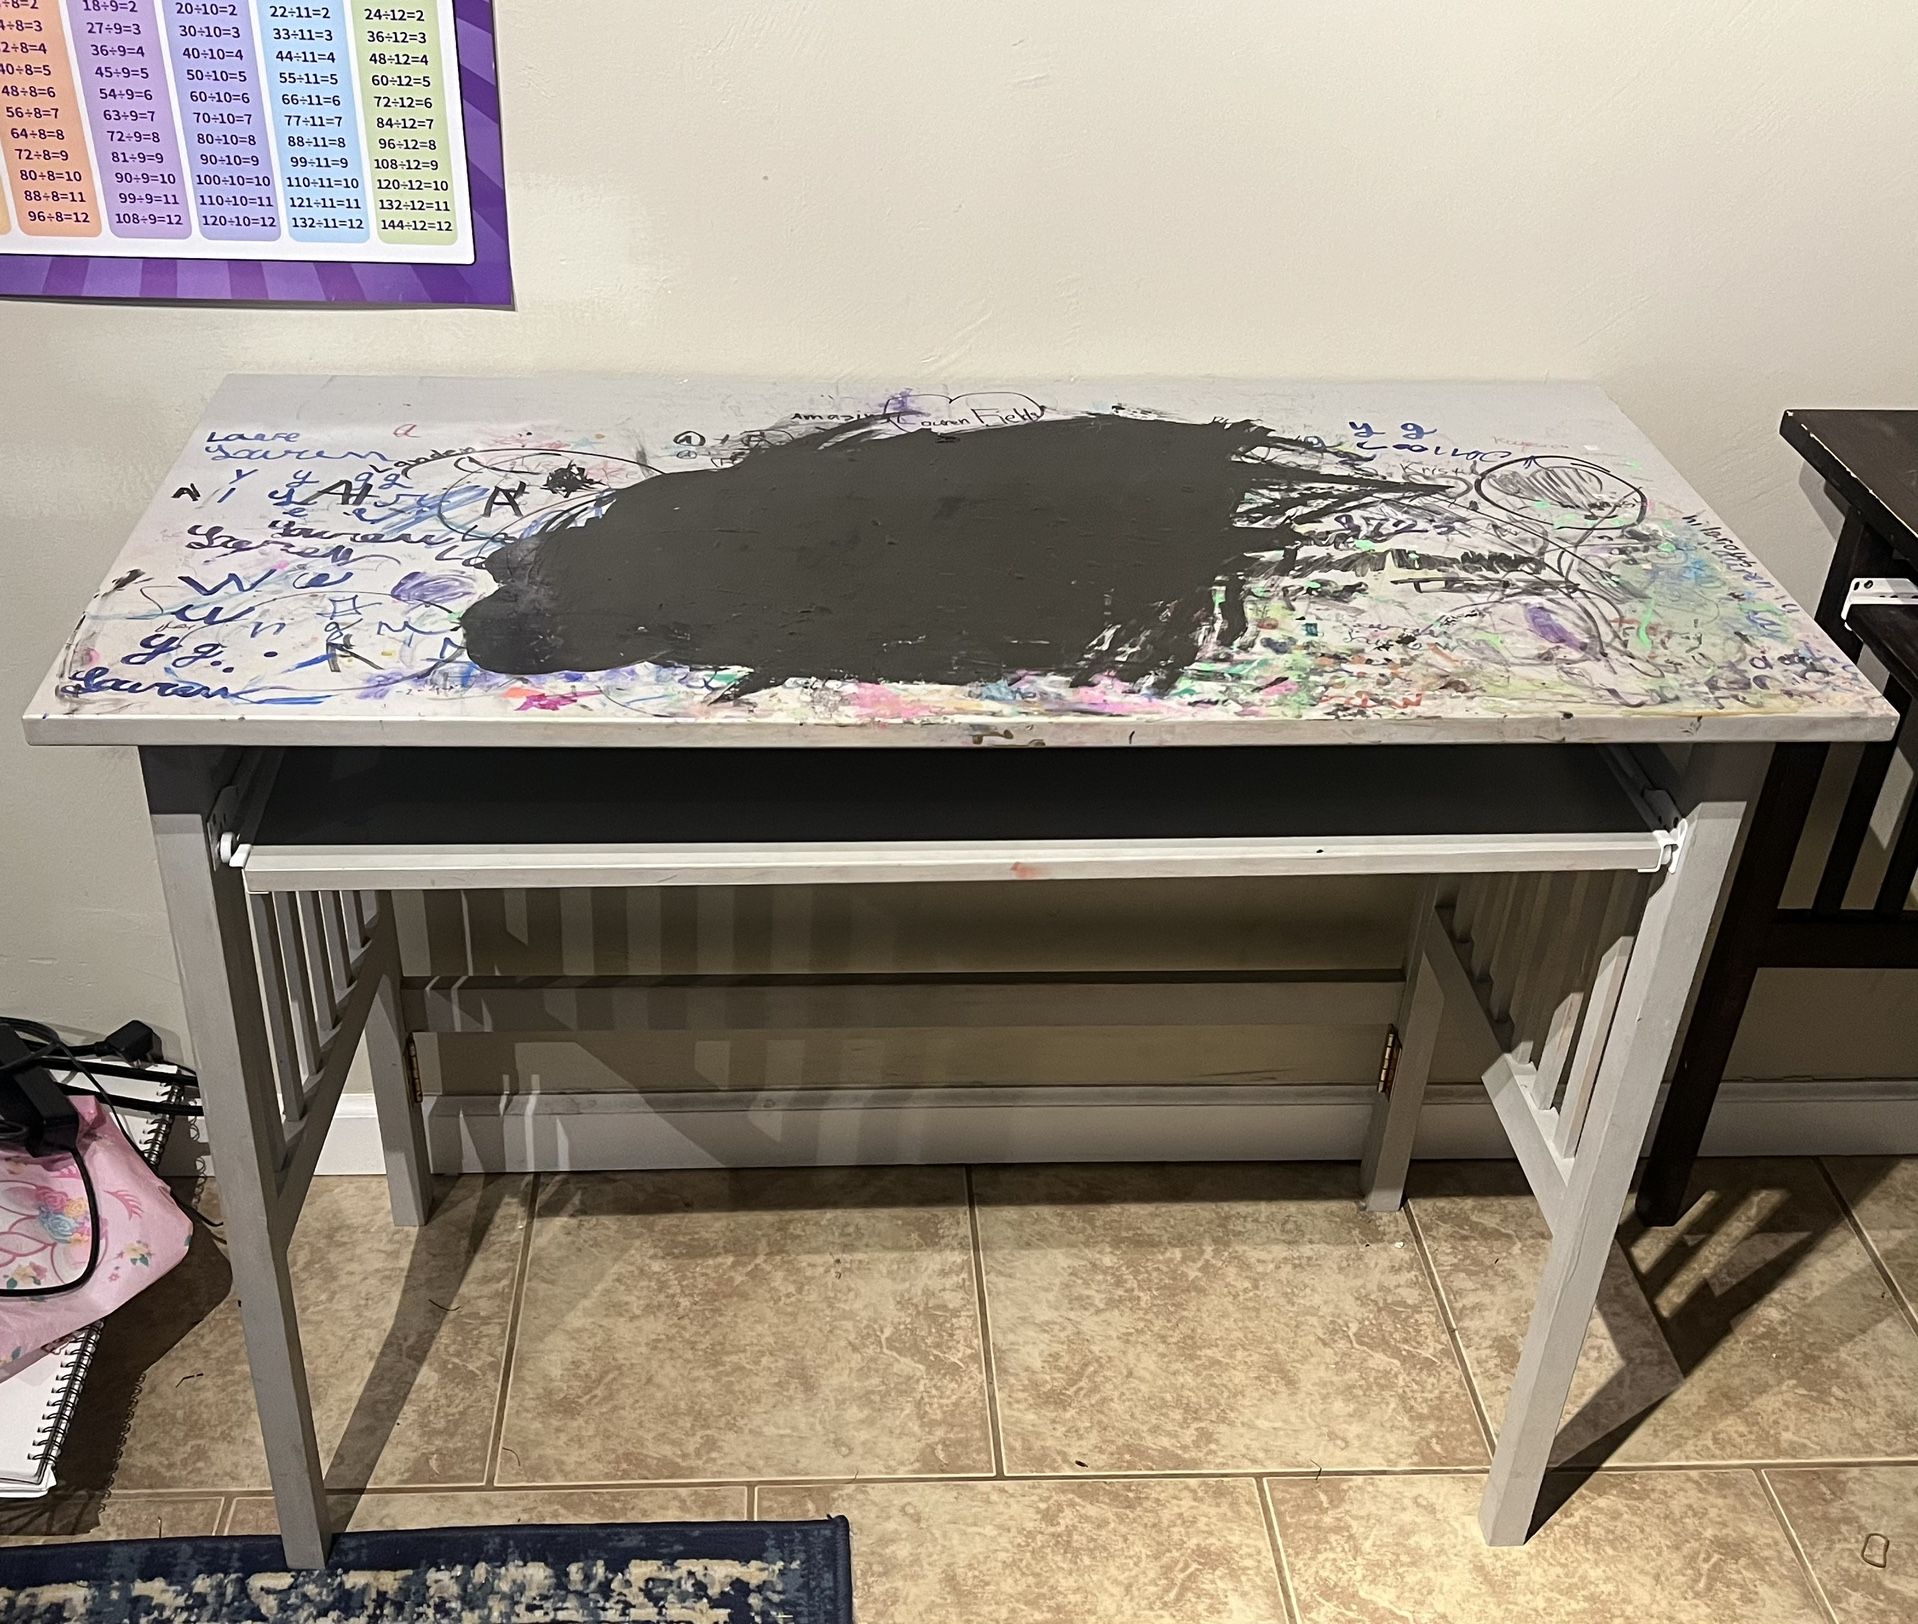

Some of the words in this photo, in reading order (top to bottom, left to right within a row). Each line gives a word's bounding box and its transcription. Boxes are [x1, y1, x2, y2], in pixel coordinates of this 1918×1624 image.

[82, 0, 139, 13] 18÷9=2
[174, 1, 239, 17] 20÷10=2
[268, 5, 332, 20] 22÷11=2
[363, 7, 426, 22] 24÷12=2
[85, 21, 142, 36] 27÷9=3
[178, 24, 241, 39] 30÷10=3
[272, 27, 334, 42] 33÷11=3
[366, 30, 427, 45] 36÷12=3
[0, 40, 48, 55] 2÷8=4
[90, 43, 146, 58] 36÷9=4
[182, 47, 244, 61] 40÷10=4
[275, 50, 337, 64] 44÷11=4
[368, 52, 430, 66] 48÷12=4
[94, 66, 150, 80] 45÷9=5
[186, 68, 248, 83] 50÷10=5
[278, 71, 339, 86] 55÷11=5
[371, 74, 431, 88] 60÷12=5
[0, 84, 57, 99] 48÷8=6
[99, 87, 153, 101] 54÷9=6
[189, 90, 251, 104] 60÷10=6
[281, 93, 341, 107] 66÷11=6
[372, 95, 433, 109] 72÷12=6
[5, 105, 60, 120] 56÷8=7
[102, 109, 156, 122] 63÷9=7
[192, 111, 253, 126] 70÷10=7
[283, 114, 343, 128] 77÷11=7
[376, 116, 435, 130] 84÷12=7
[10, 127, 66, 141] 64÷8=8
[105, 130, 161, 144] 72÷9=8
[196, 132, 257, 146] 80÷10=8
[287, 135, 347, 149] 88÷11=8
[378, 137, 437, 151] 96÷12=8
[13, 148, 69, 162] 72÷8=9
[110, 151, 164, 164] 81÷9=9
[199, 153, 260, 167] 90÷10=9
[289, 156, 349, 169] 99÷11=9
[373, 158, 439, 171] 108÷12=9
[19, 169, 83, 183] 80÷8=10
[114, 171, 177, 185] 90÷9=10
[195, 173, 271, 187] 100÷10=10
[285, 176, 360, 190] 110÷11=10
[376, 178, 450, 192] 120÷12=10
[23, 189, 87, 203] 88÷8=11
[118, 192, 180, 206] 99÷9=11
[198, 194, 275, 208] 110÷10=11
[288, 196, 362, 210] 121÷11=11
[378, 198, 452, 212] 132÷12=11
[27, 210, 91, 224] 96÷8=12
[114, 212, 184, 226] 108÷9=12
[201, 214, 277, 228] 120÷10=12
[291, 216, 365, 230] 132÷11=12
[380, 219, 453, 232] 144÷12=12
